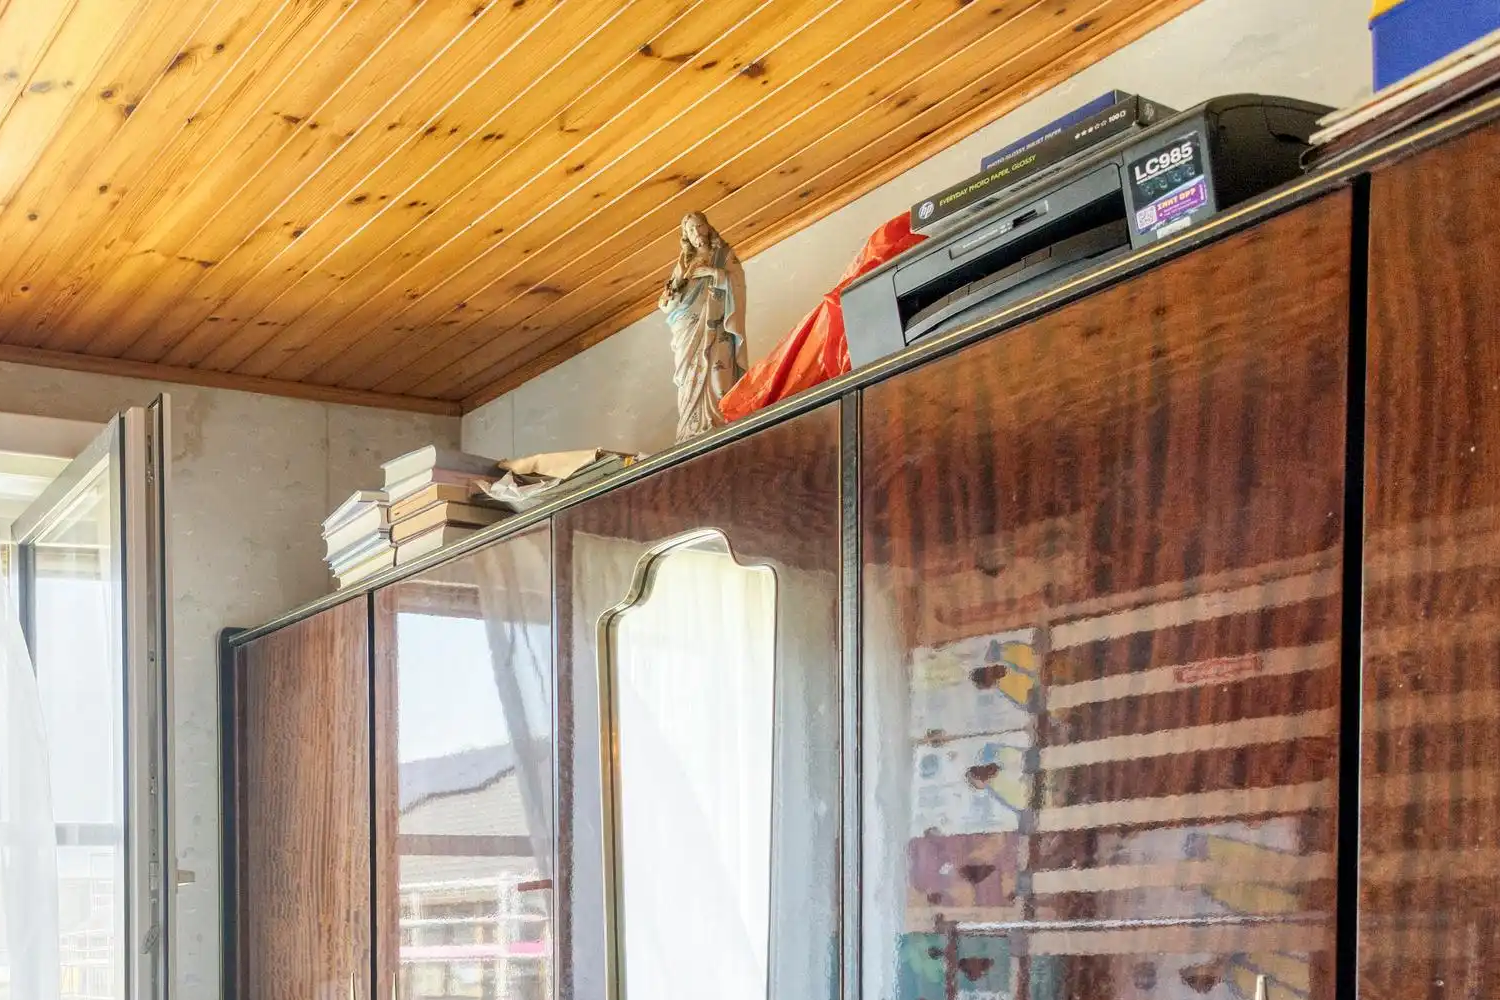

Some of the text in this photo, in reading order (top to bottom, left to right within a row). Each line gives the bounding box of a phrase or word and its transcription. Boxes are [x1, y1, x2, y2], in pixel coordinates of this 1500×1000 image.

[939, 187, 969, 207] EVERYDAY
[968, 177, 990, 192] PHOTO
[1011, 153, 1037, 171] GLOSSY
[1134, 141, 1193, 181] LC985
[920, 202, 934, 219] hp
